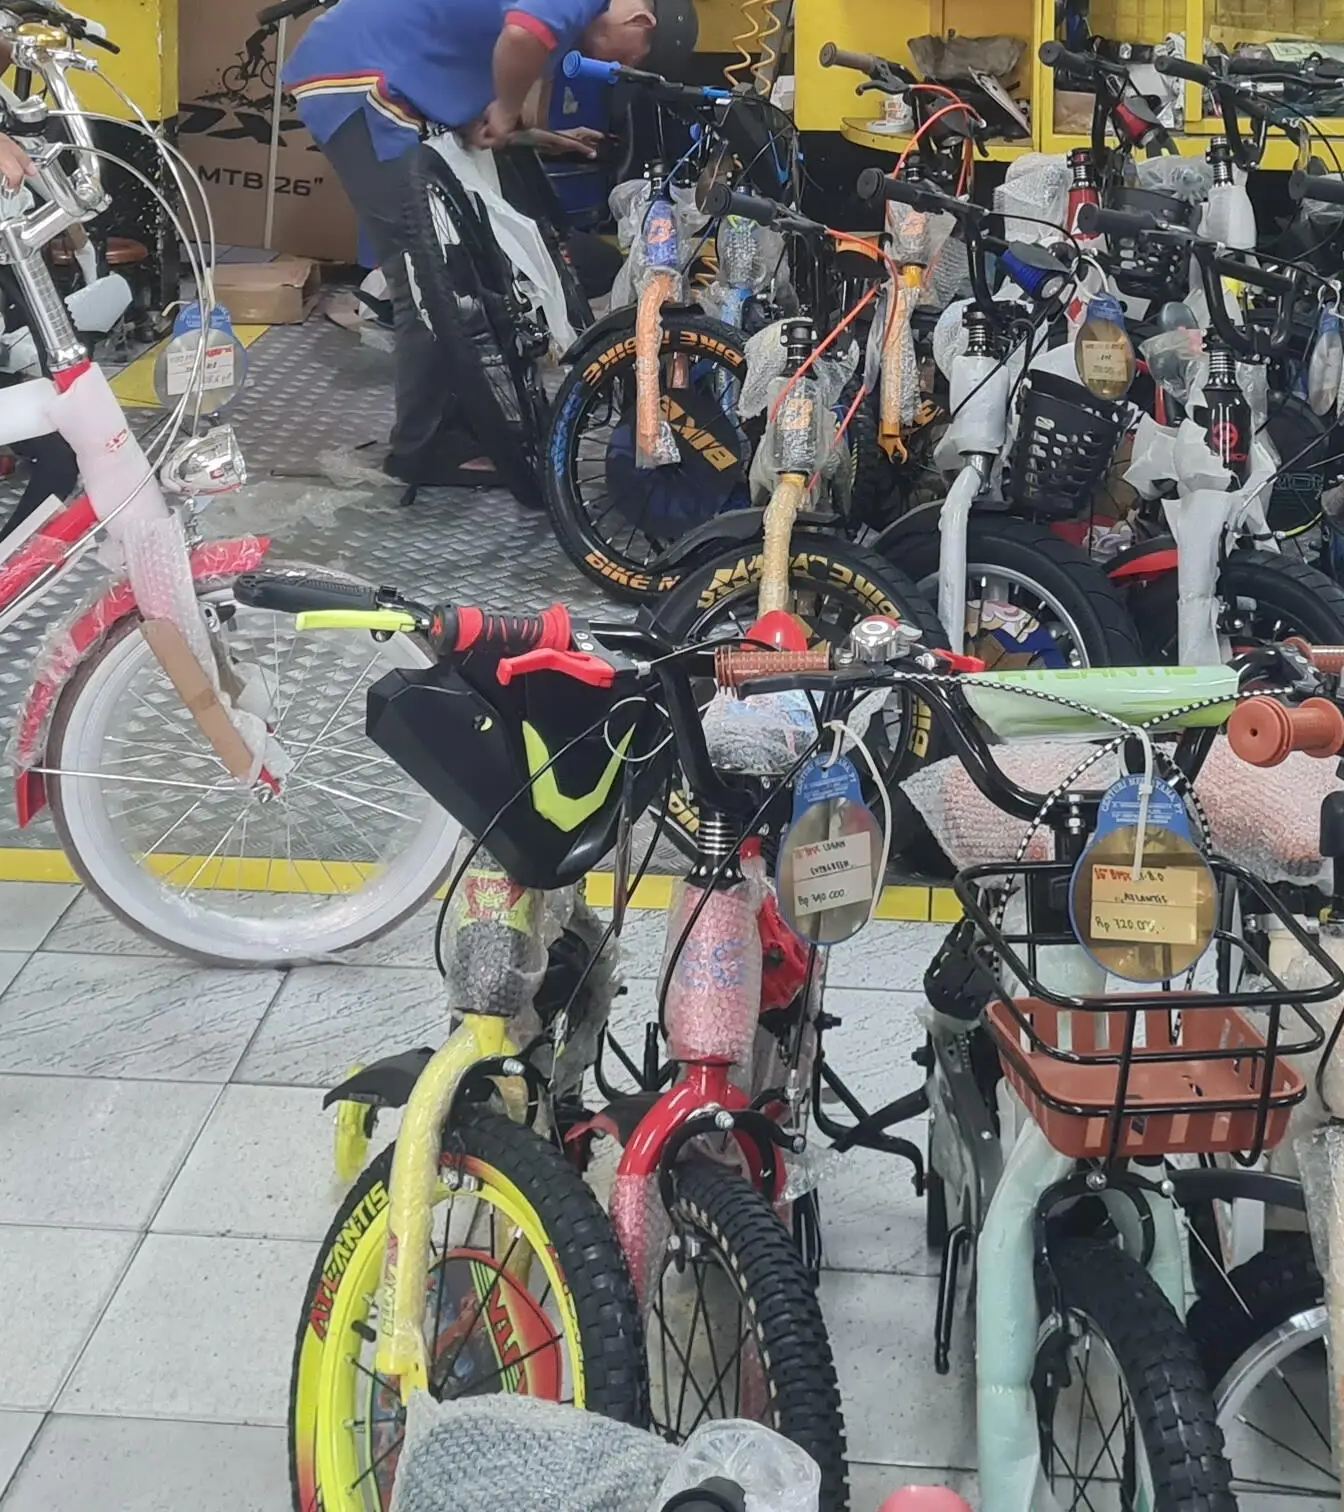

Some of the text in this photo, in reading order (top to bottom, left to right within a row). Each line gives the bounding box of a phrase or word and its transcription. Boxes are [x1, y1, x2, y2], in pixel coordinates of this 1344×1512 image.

[197, 165, 323, 197] MTB 26"
[310, 1180, 390, 1344] ATLANTIS
